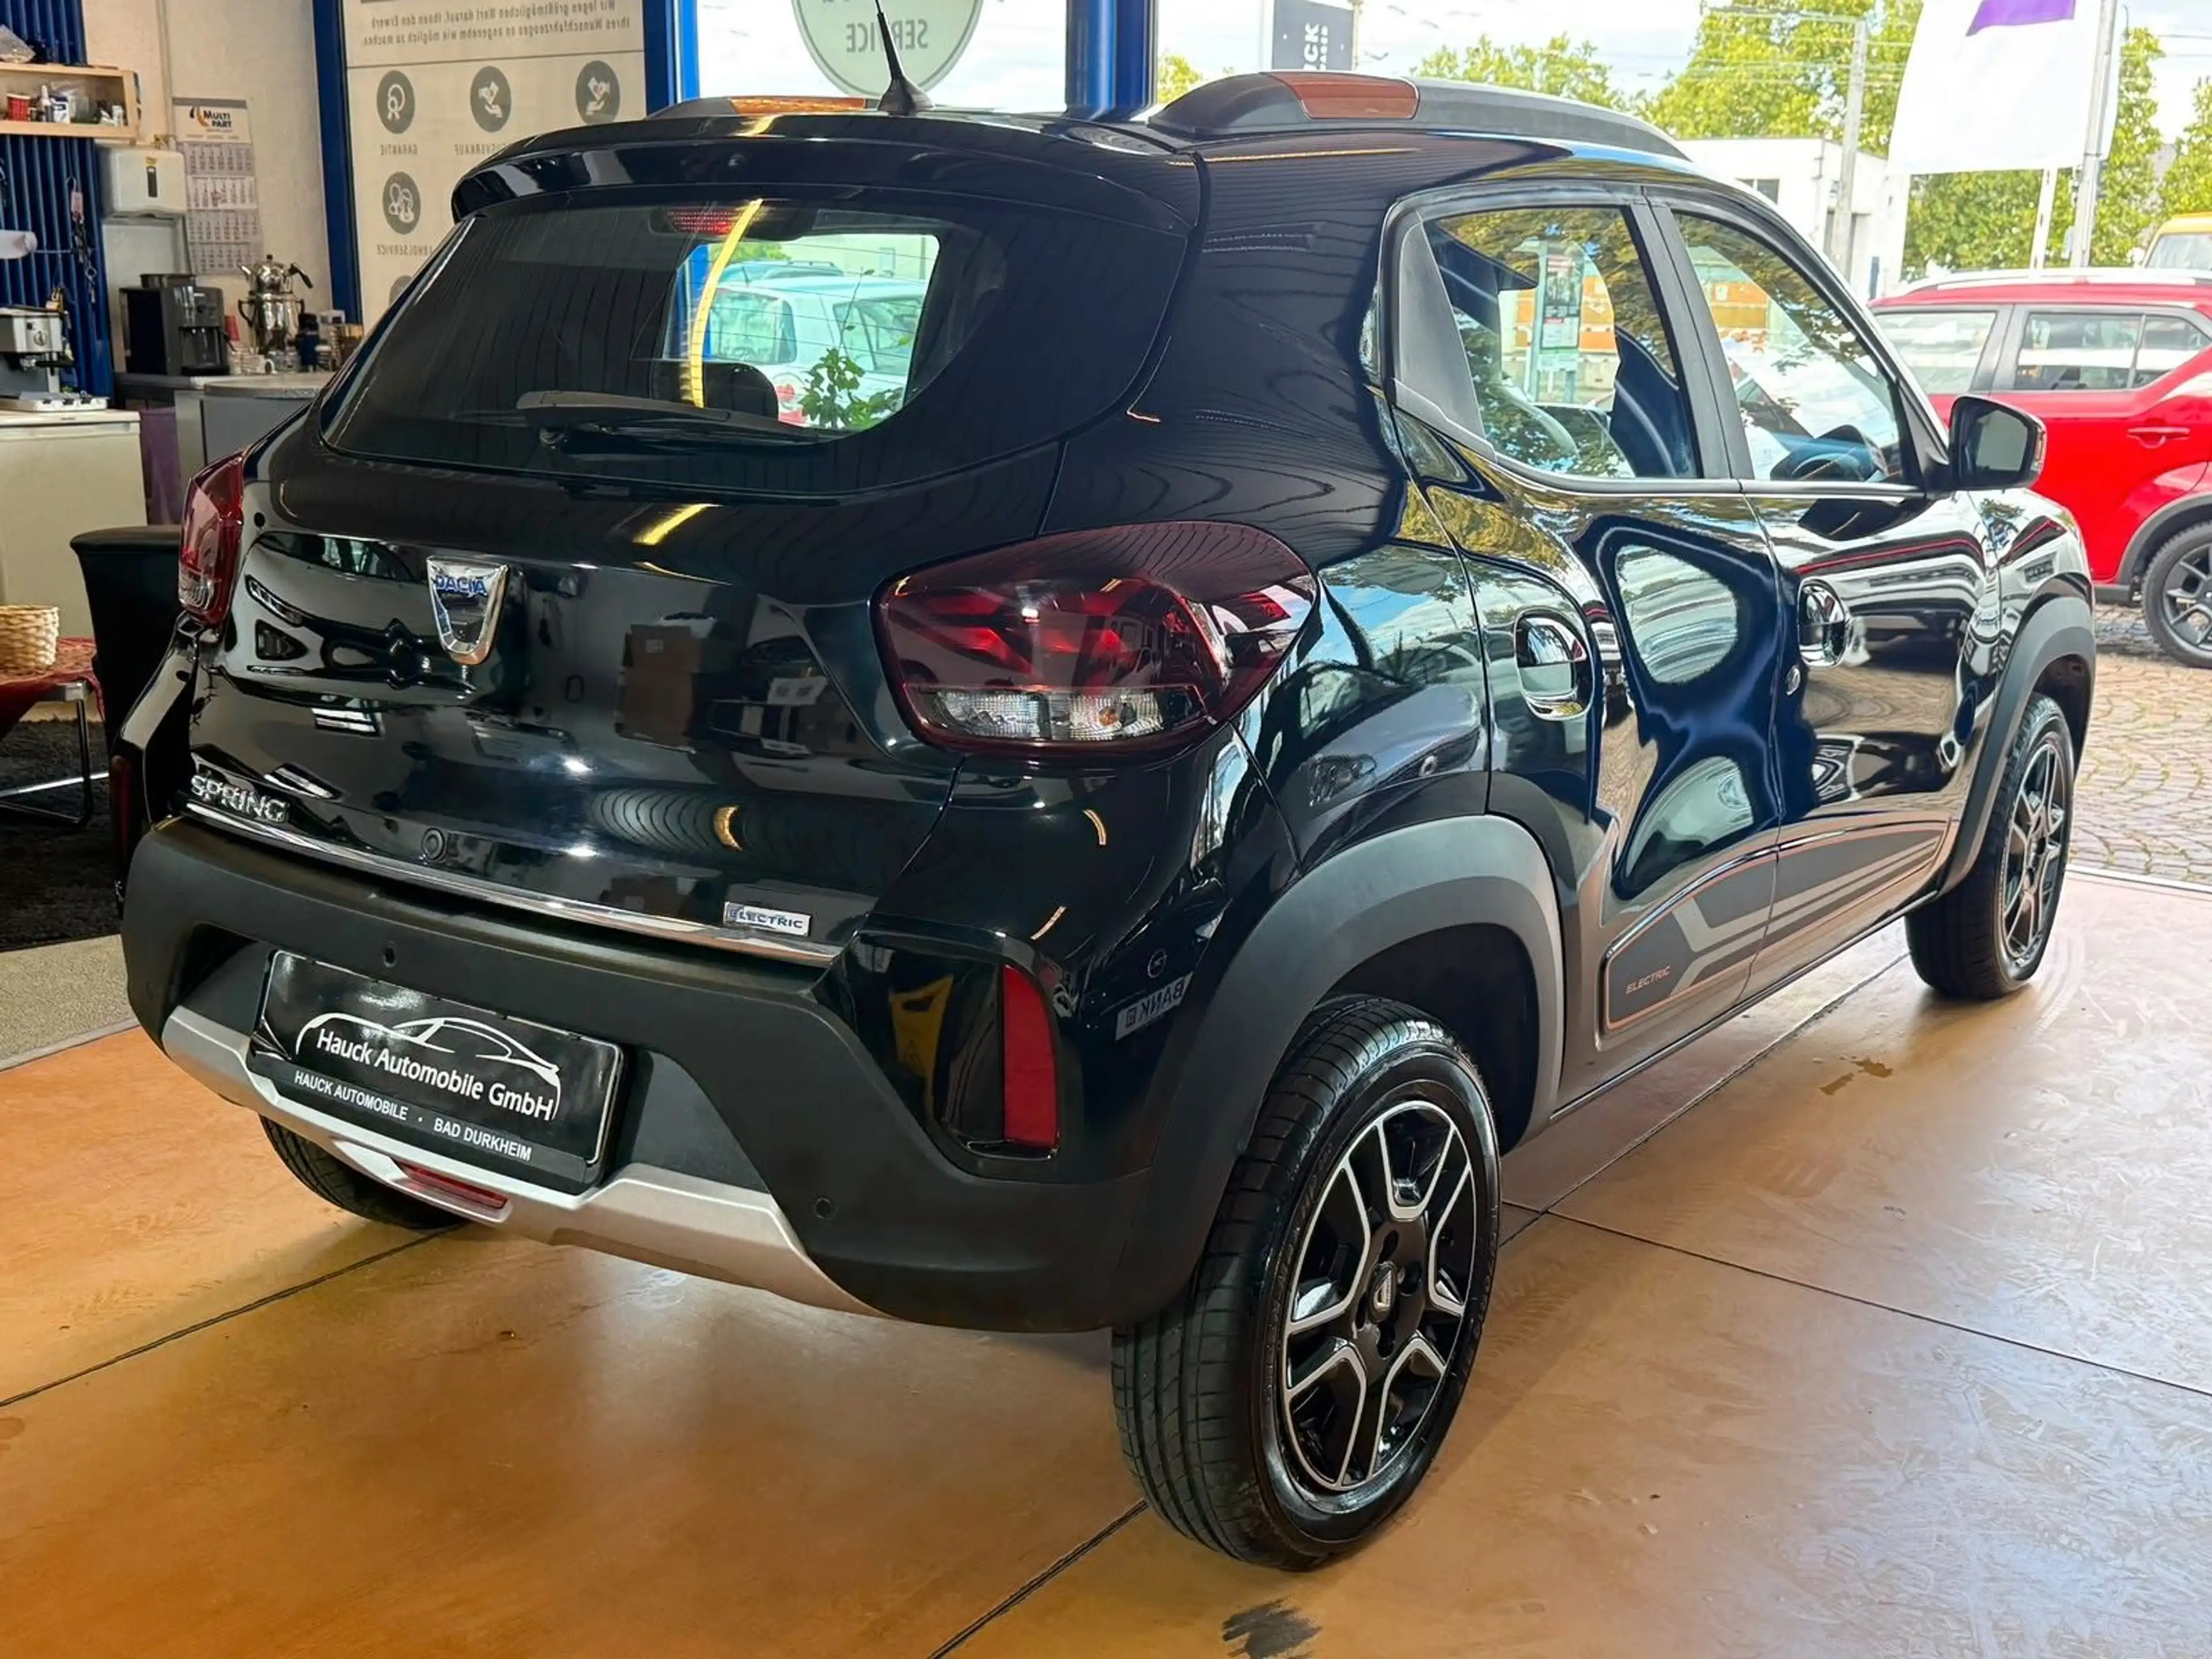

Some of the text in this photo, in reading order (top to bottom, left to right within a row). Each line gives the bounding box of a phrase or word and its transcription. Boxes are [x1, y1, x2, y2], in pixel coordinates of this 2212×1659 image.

[435, 574, 488, 597] DACIA
[191, 775, 290, 823] SPRING
[730, 909, 803, 929] ELECTRIC
[1626, 964, 1671, 995] ELECTRIC
[317, 1028, 554, 1122] Hauck Automobile GmbH
[294, 1070, 532, 1161] HAUCK AUTOMOBILE BAD DURKHEIM
